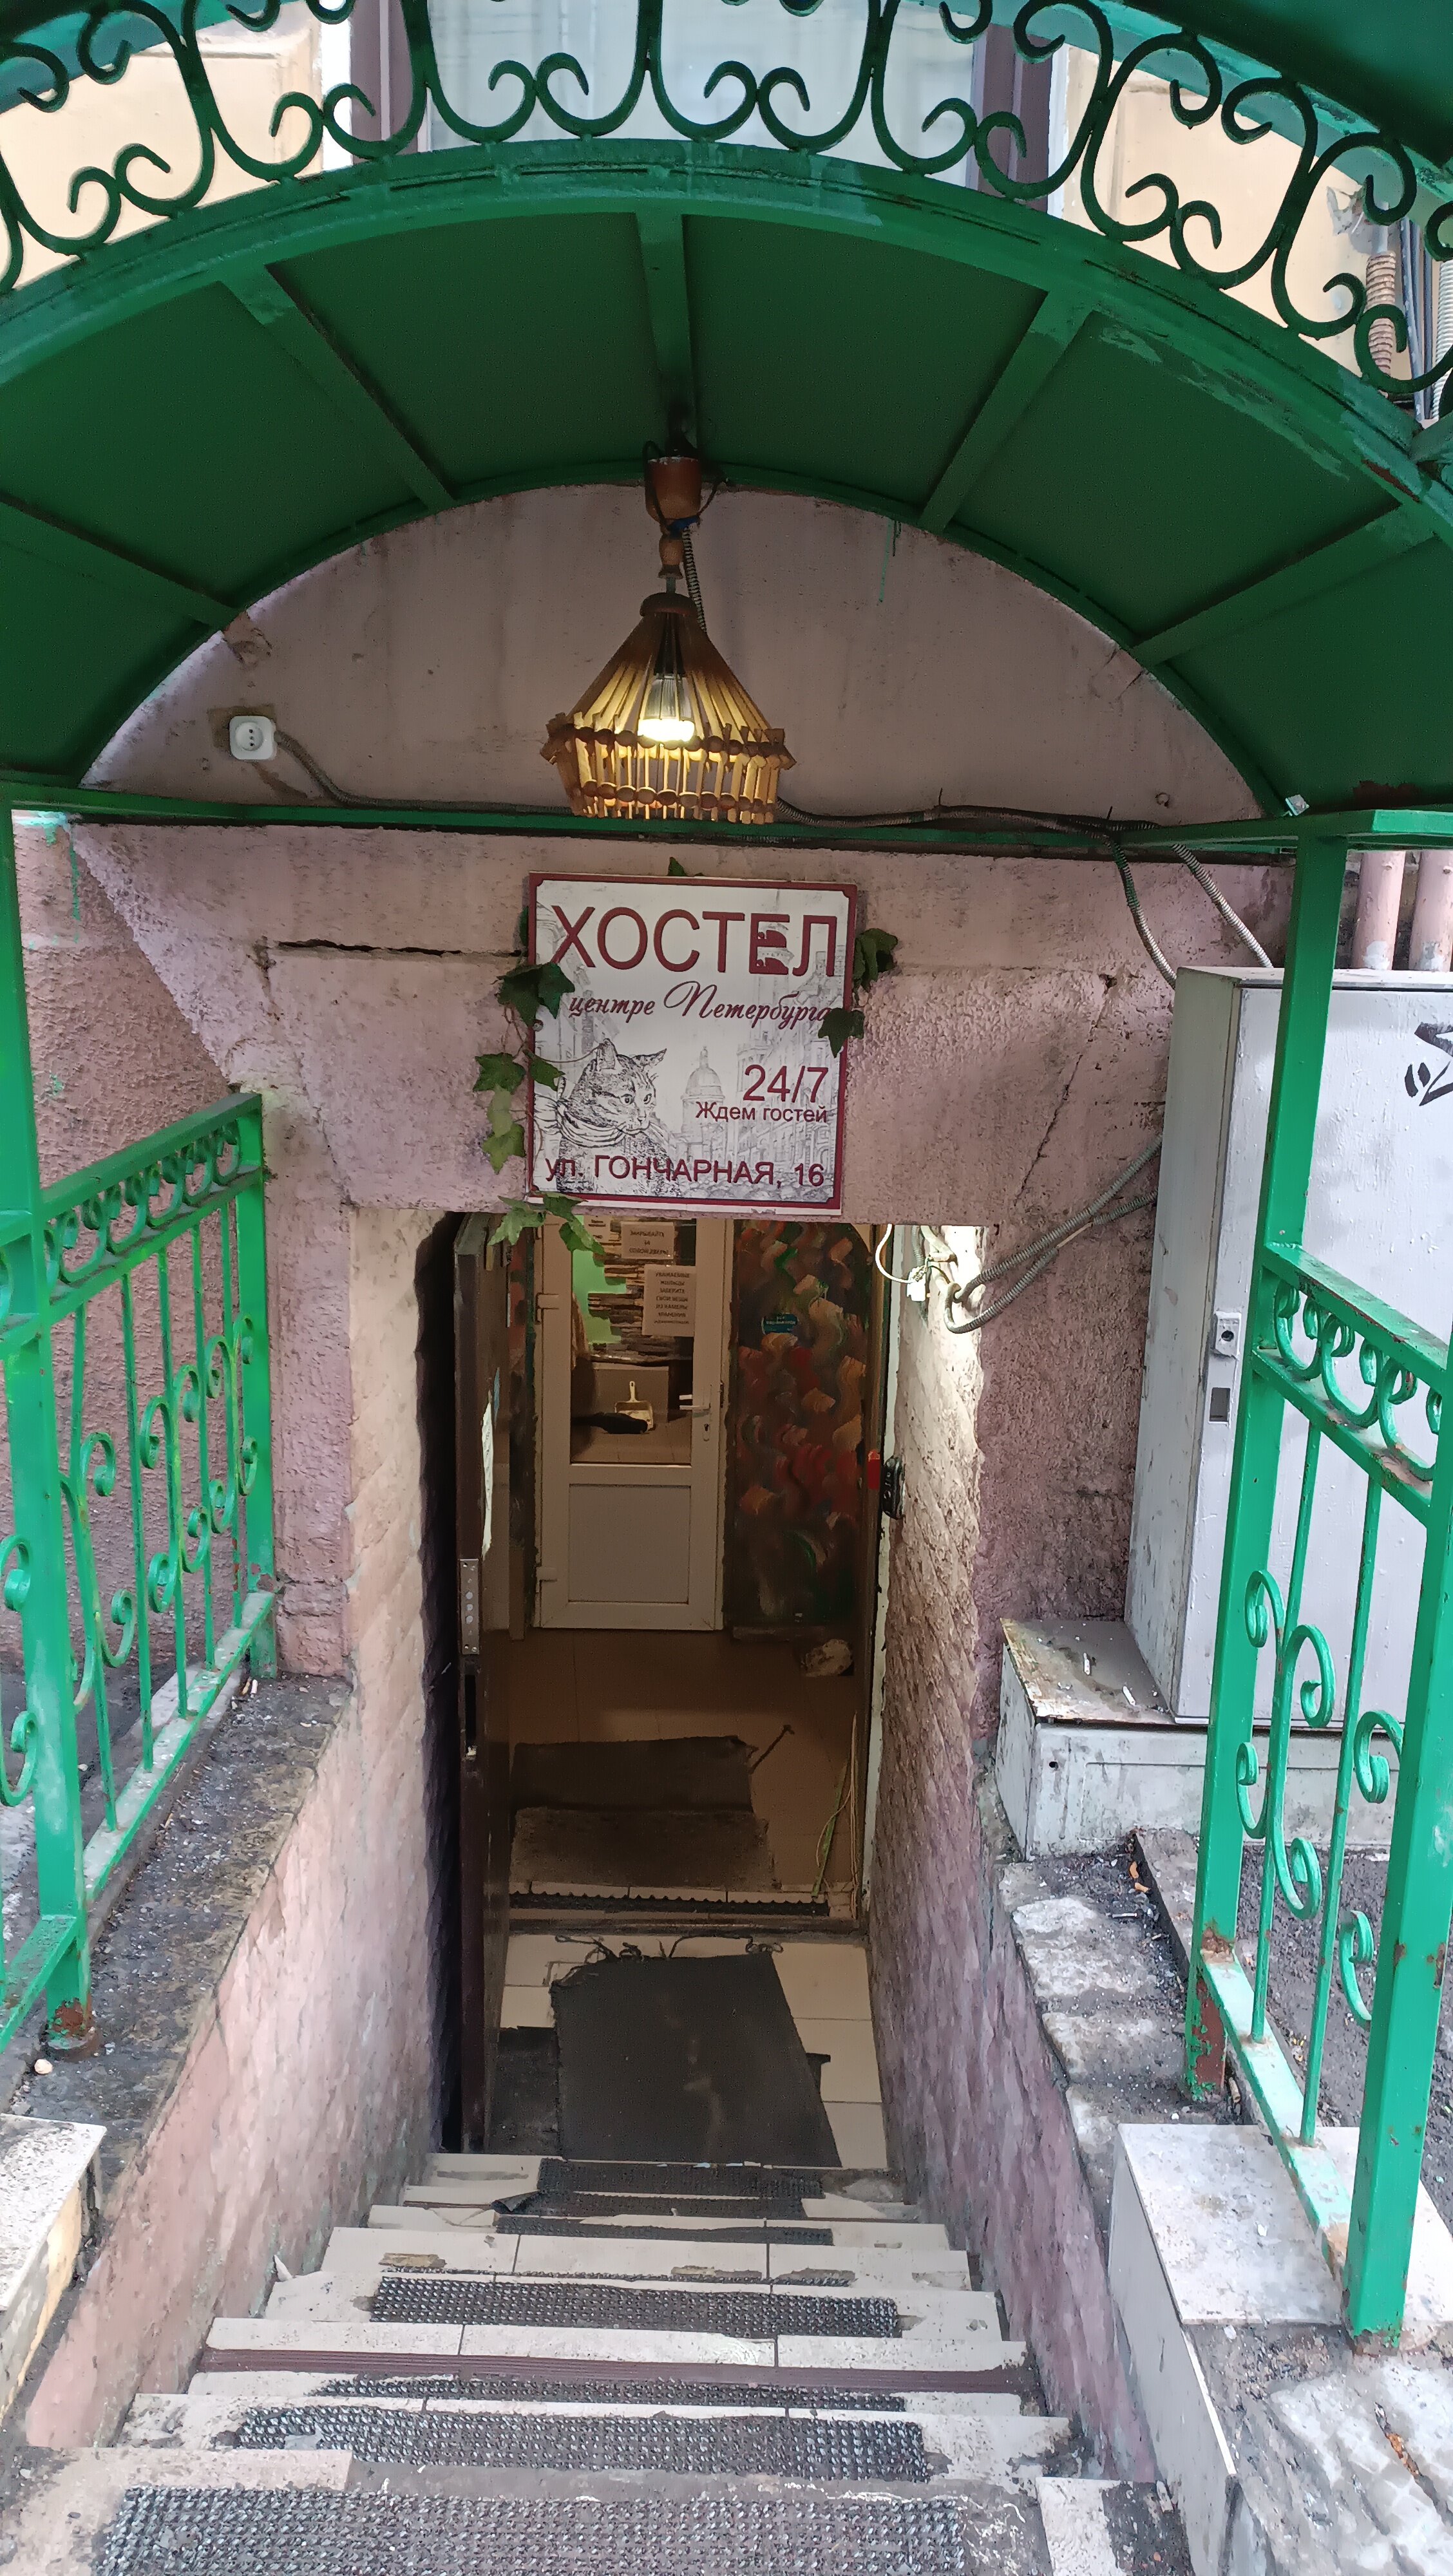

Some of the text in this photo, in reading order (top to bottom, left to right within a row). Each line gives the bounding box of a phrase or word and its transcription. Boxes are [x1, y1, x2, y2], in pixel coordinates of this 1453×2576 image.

[551, 905, 837, 977] ХОСТЕЛ
[569, 998, 656, 1023] центре
[743, 1065, 829, 1103] 24/7
[696, 1101, 827, 1123] Ждем гостей
[545, 1155, 824, 1189] ул. ГОНЧАРНАЯ, 16
